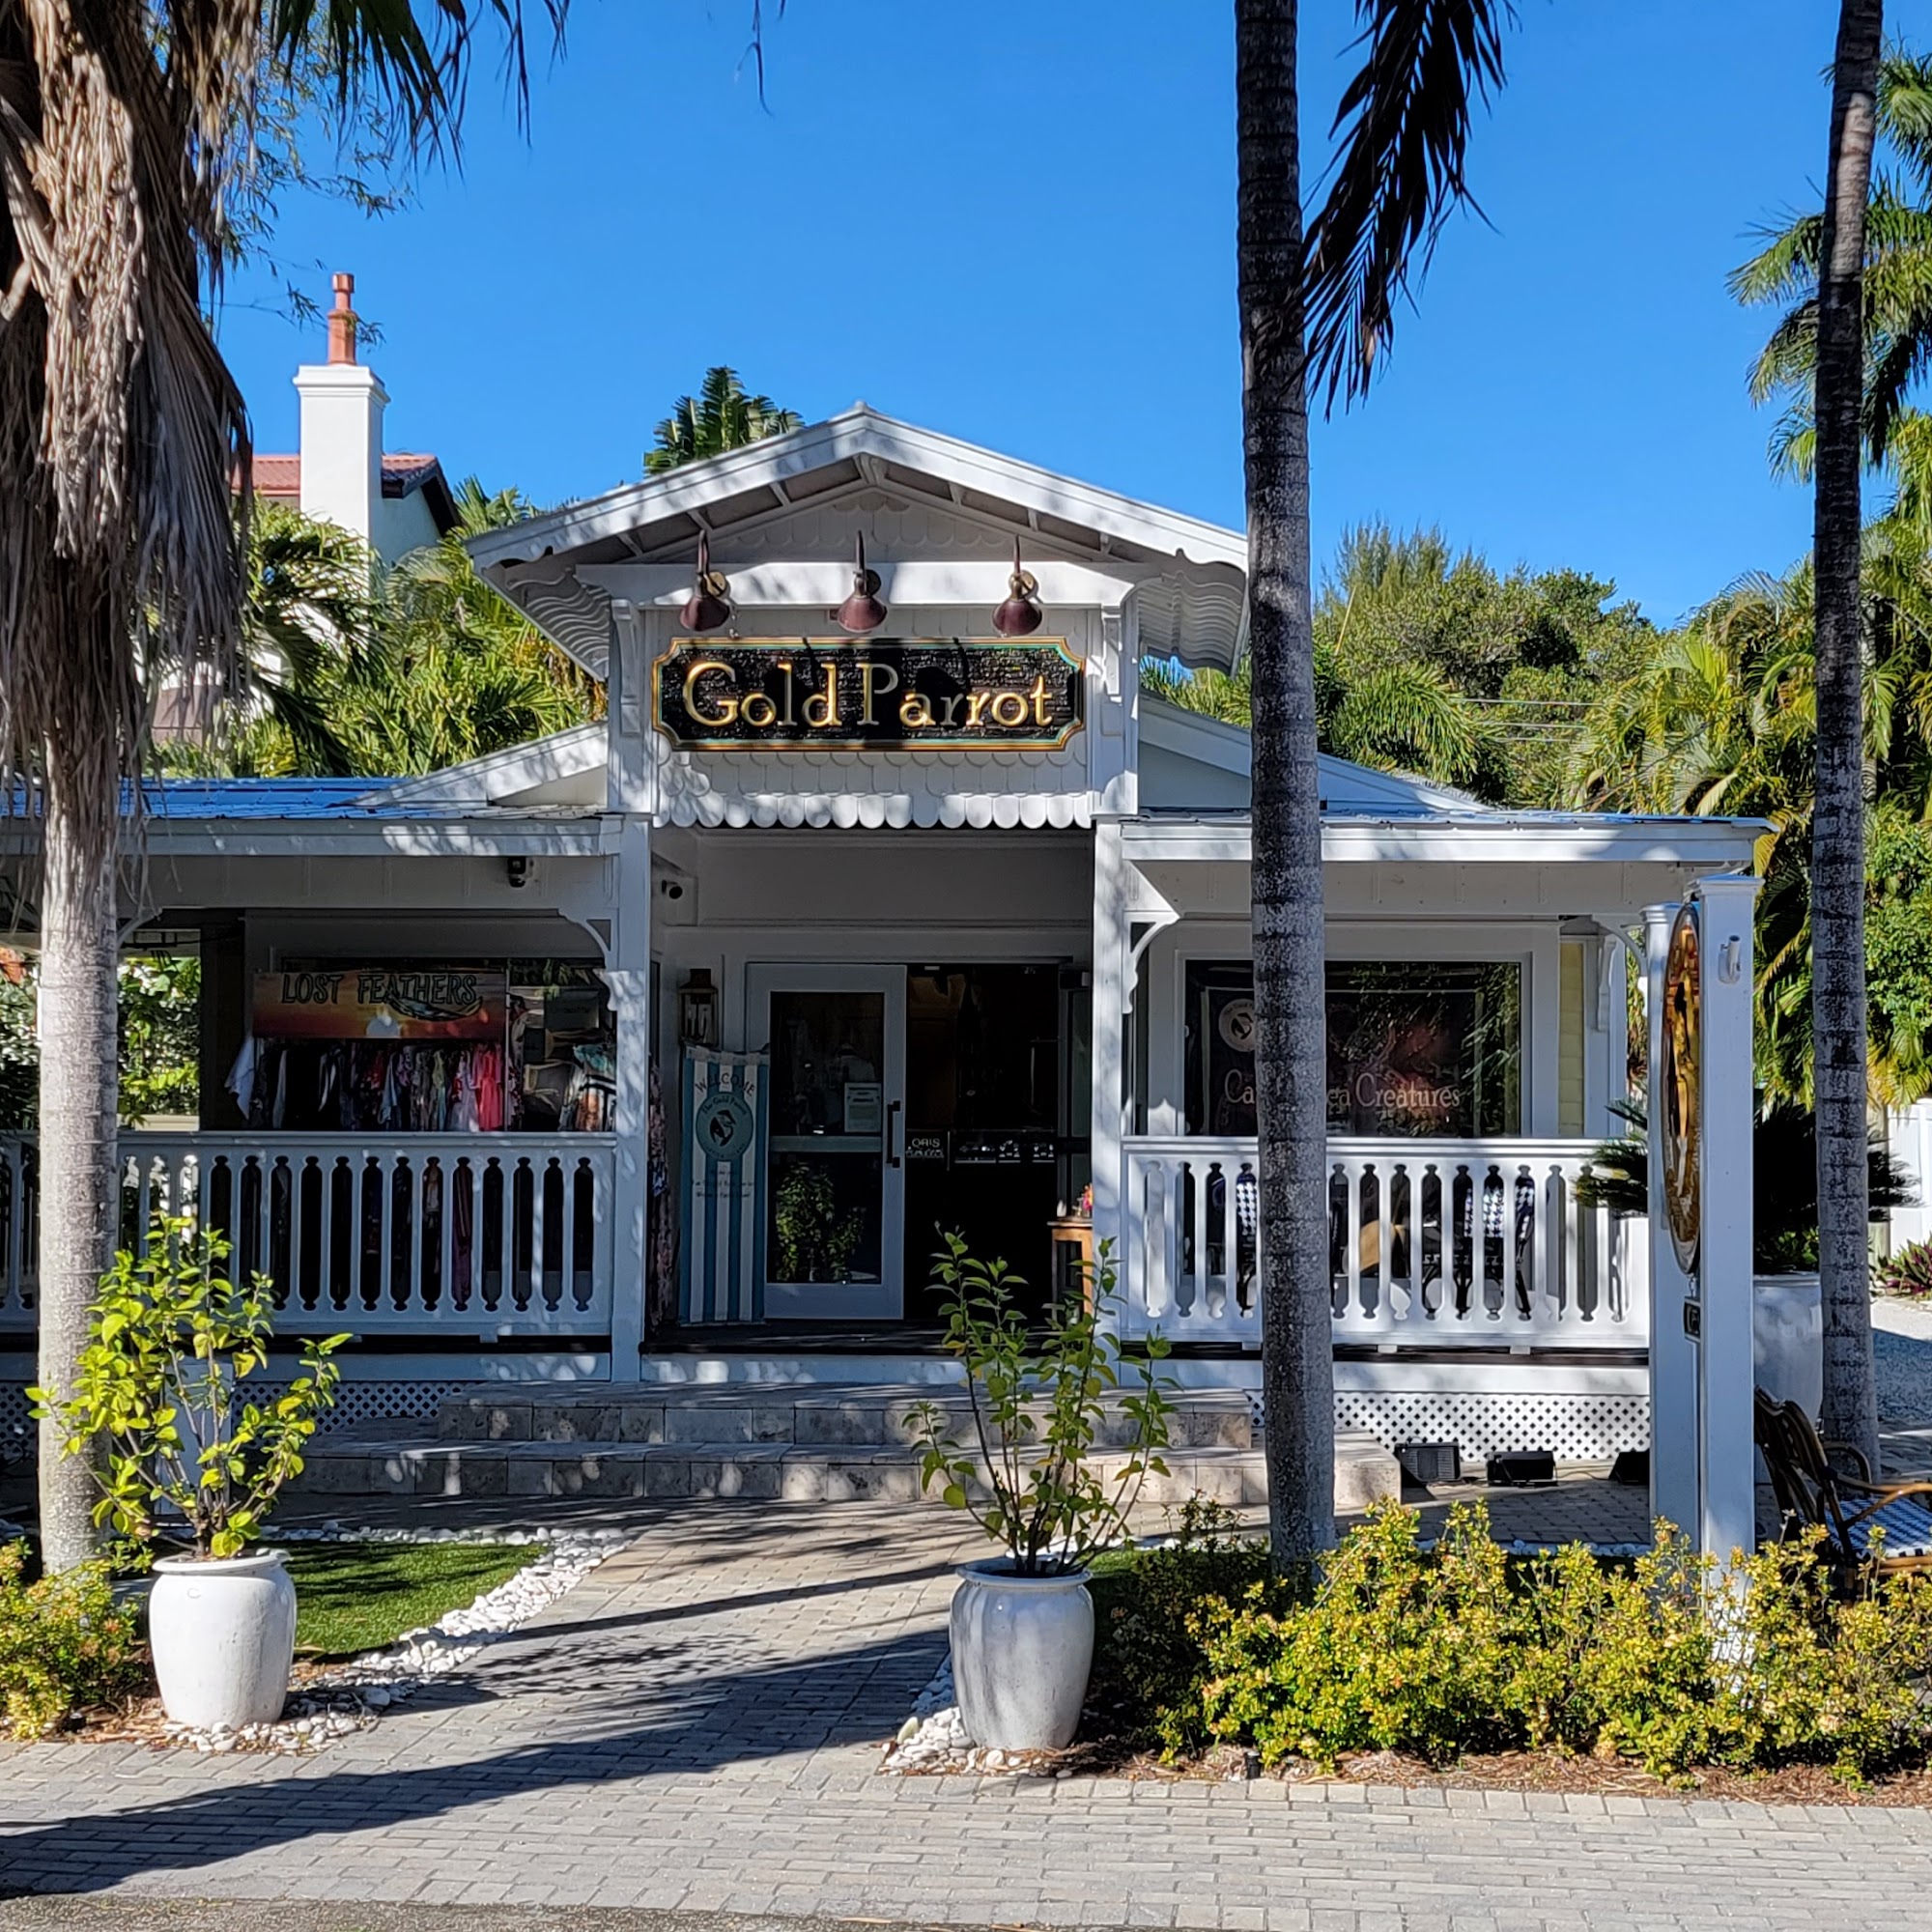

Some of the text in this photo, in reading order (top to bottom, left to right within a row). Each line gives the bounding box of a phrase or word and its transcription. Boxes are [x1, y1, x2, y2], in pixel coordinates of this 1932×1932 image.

[682, 661, 1054, 728] Gold Parrot
[281, 973, 478, 1006] LOST FEATHERS
[694, 1072, 755, 1097] WELCOME
[1224, 1068, 1462, 1109] Ca ea Creatures
